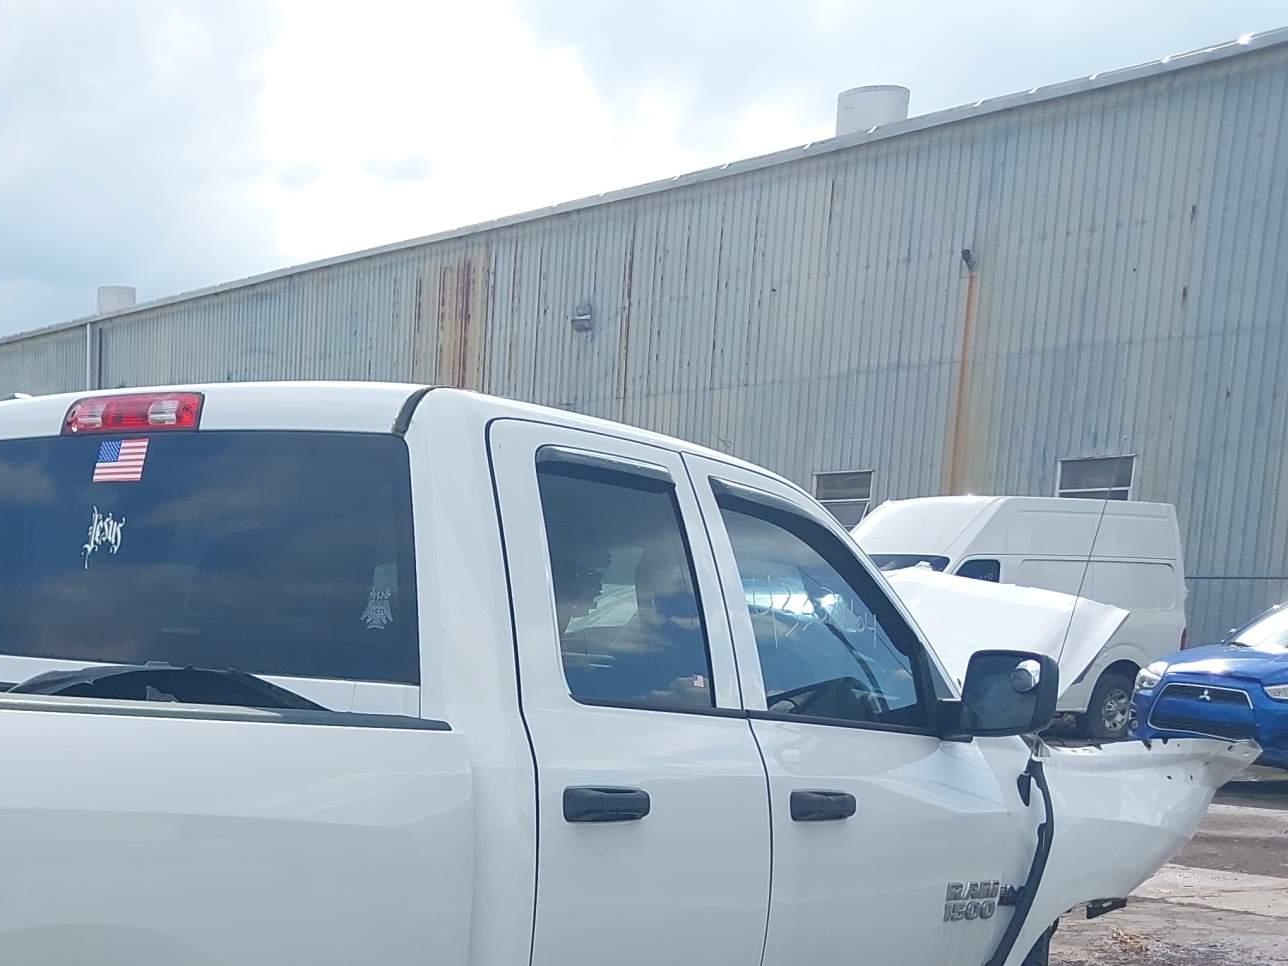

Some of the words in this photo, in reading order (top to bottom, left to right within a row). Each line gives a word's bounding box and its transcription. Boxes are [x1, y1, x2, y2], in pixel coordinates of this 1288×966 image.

[80, 504, 126, 570] Jesus
[946, 881, 999, 901] RAM
[943, 901, 996, 922] 1500
